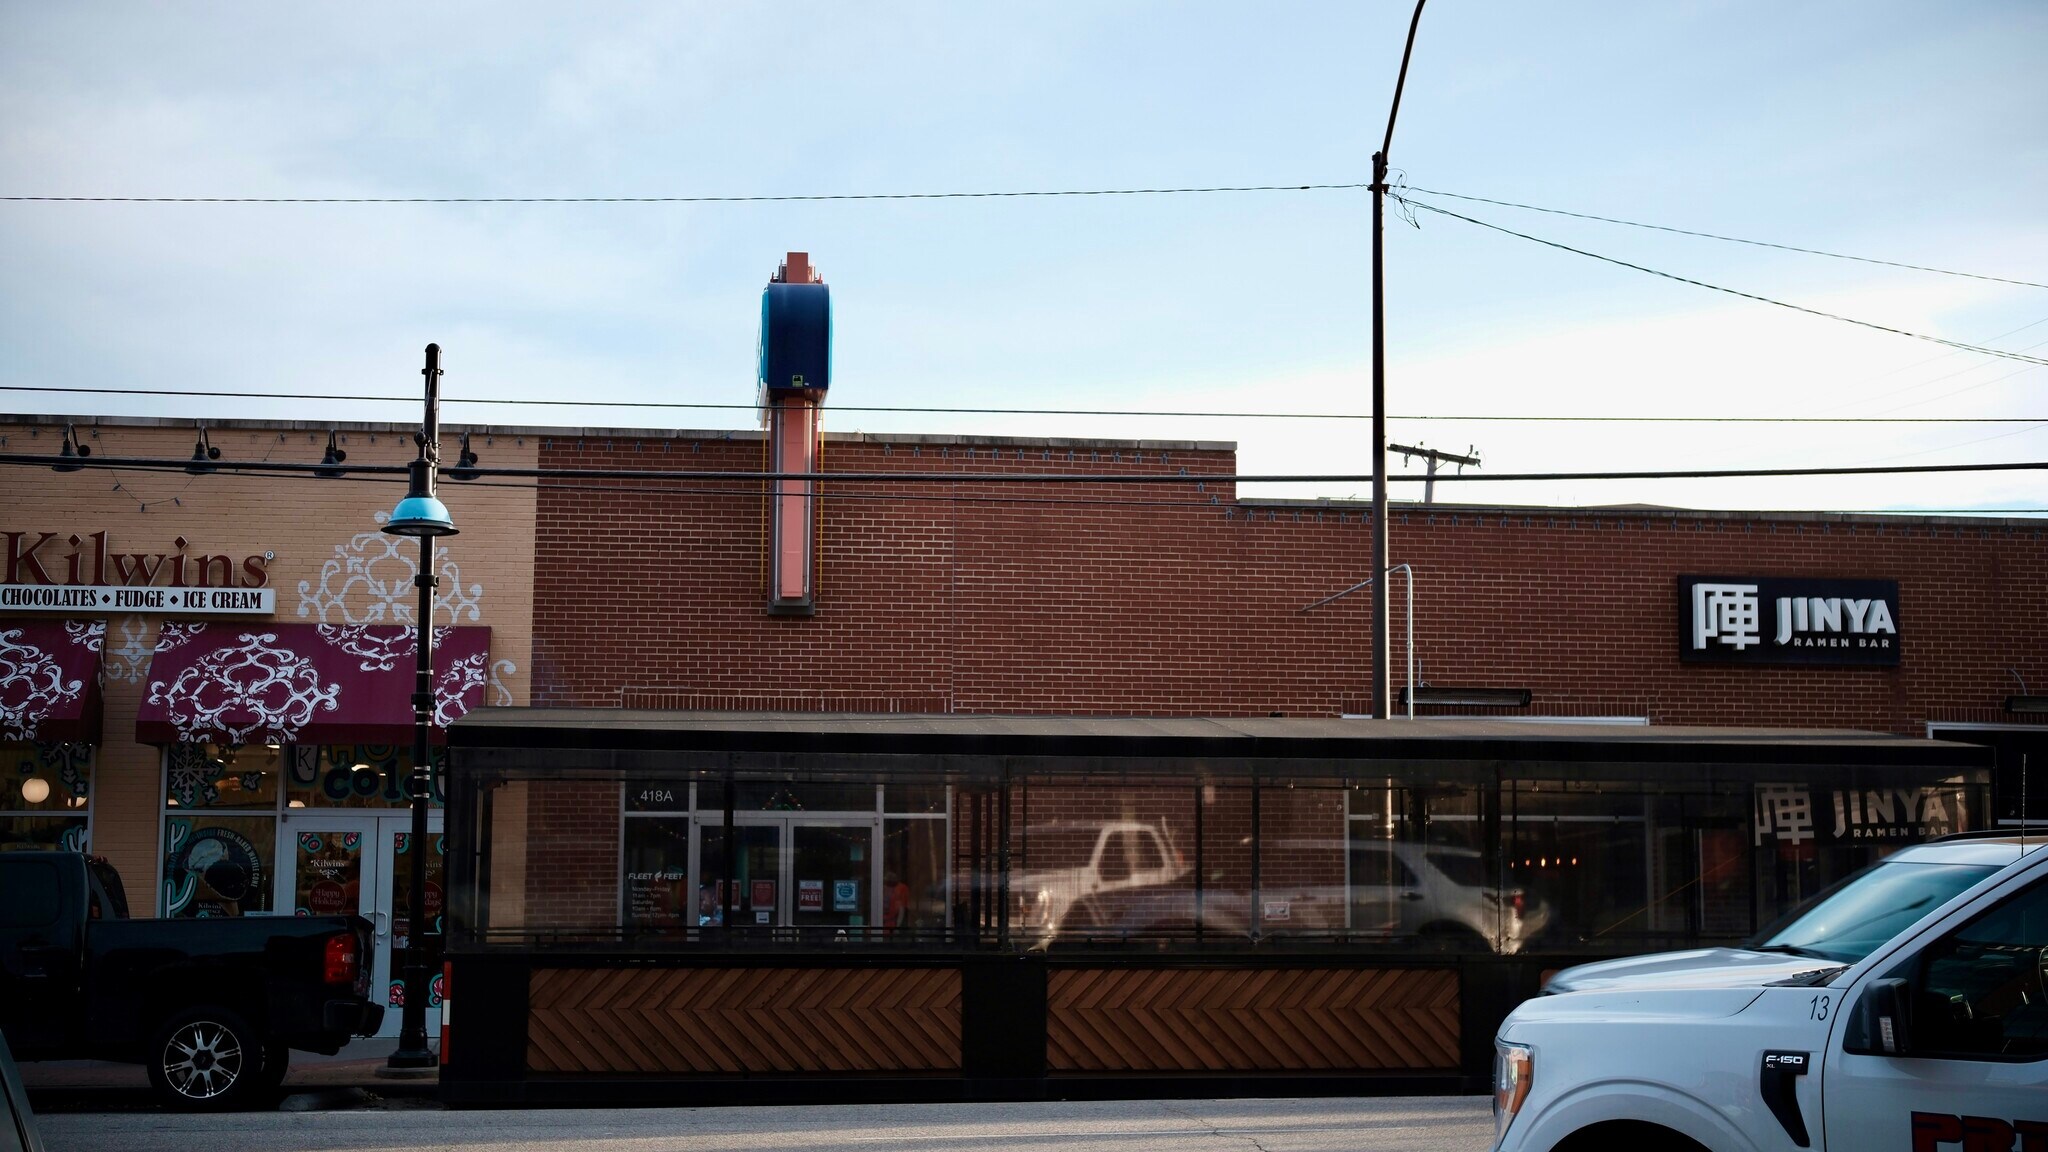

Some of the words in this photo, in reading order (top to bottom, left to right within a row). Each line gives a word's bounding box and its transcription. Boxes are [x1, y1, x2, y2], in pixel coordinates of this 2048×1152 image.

[0, 530, 269, 588] Kilwins
[1, 588, 97, 607] CHOCOLATES
[115, 590, 164, 608] FUDGE
[183, 591, 206, 608] ICE
[211, 591, 262, 609] CREAM
[1773, 597, 1897, 646] JINYA
[1794, 637, 1850, 649] RAMEN
[1859, 638, 1890, 649] BAR
[640, 790, 674, 802] 418A
[1832, 786, 1949, 839] JINYA
[1853, 826, 1909, 838] RAMEN
[1917, 826, 1949, 836] BAR
[313, 858, 345, 868] Kilwins
[628, 871, 653, 880] FLEET
[663, 871, 684, 880] FEET
[1810, 995, 1830, 1021] 13
[1765, 1054, 1804, 1064] F-150
